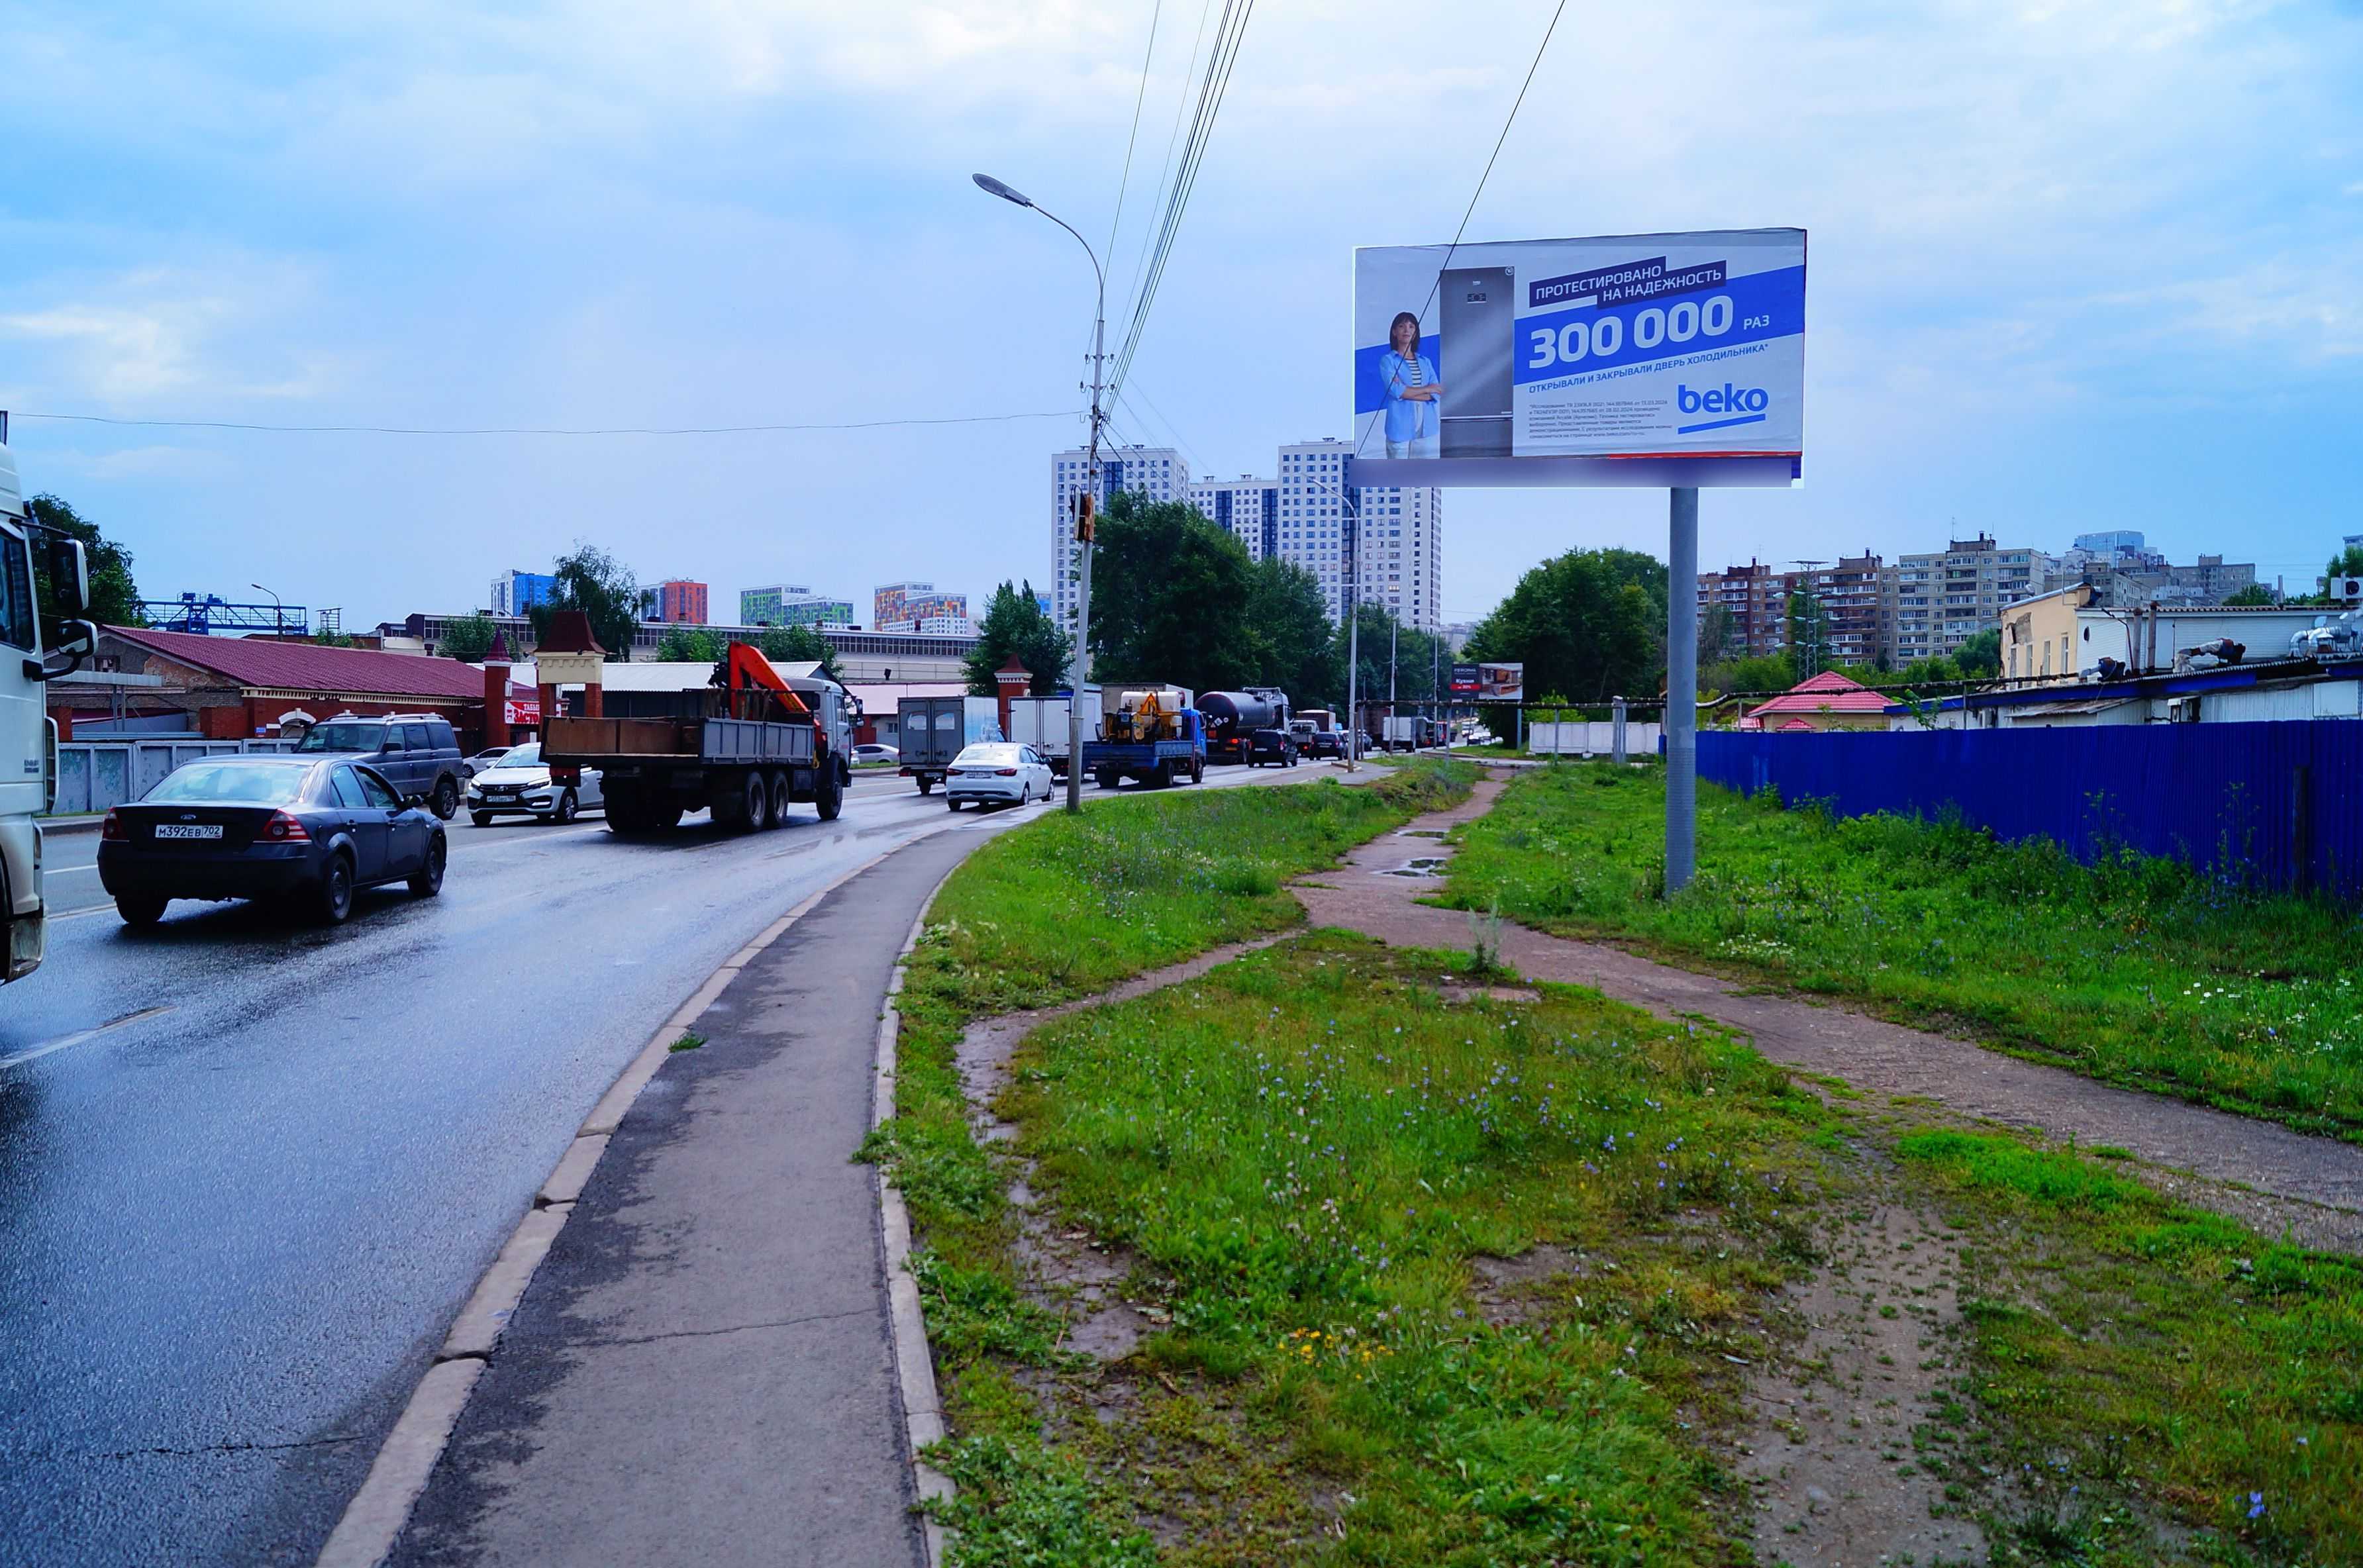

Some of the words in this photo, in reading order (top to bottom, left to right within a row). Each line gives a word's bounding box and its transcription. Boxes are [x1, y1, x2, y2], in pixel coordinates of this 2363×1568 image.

[1536, 266, 1662, 300] ПРОТЕСТИРОВАНО
[1603, 288, 1622, 302] НА
[1625, 270, 1722, 297] НАДЕЖНОСТЬ
[1529, 316, 1623, 369] 300
[1633, 295, 1734, 349] 000
[1743, 315, 1770, 330] РАЗ
[1529, 376, 1586, 394] ОТКРЫВАЛИ
[1587, 374, 1594, 383] И
[1596, 364, 1652, 382] ЗАКРЫВАЛИ
[1654, 359, 1685, 372] ДВЕРЬ
[1678, 383, 1769, 414] beko
[203, 826, 220, 835] 702
